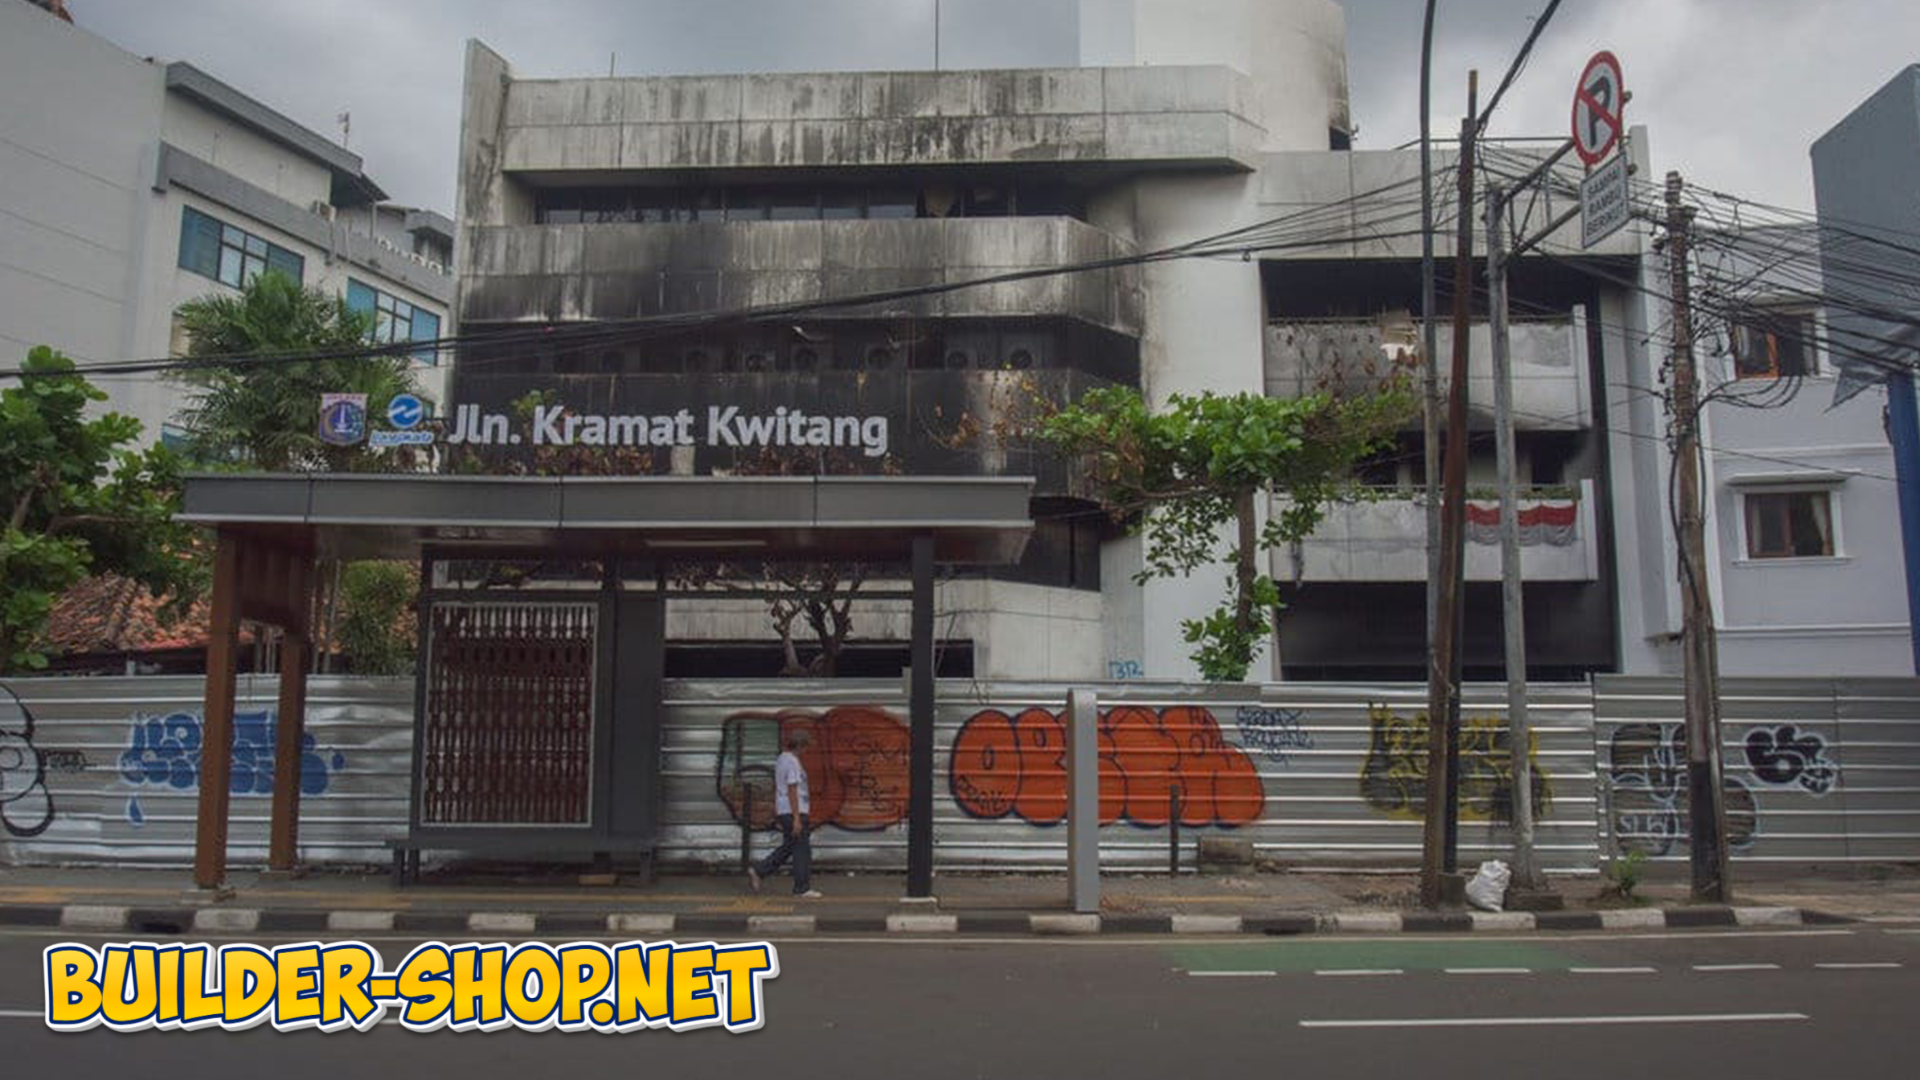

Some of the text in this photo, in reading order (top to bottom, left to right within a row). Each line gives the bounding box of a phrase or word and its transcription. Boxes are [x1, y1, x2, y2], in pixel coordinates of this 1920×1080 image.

[448, 404, 521, 445] Jln.
[532, 405, 695, 445] Kramat
[707, 405, 888, 457] Kwitang
